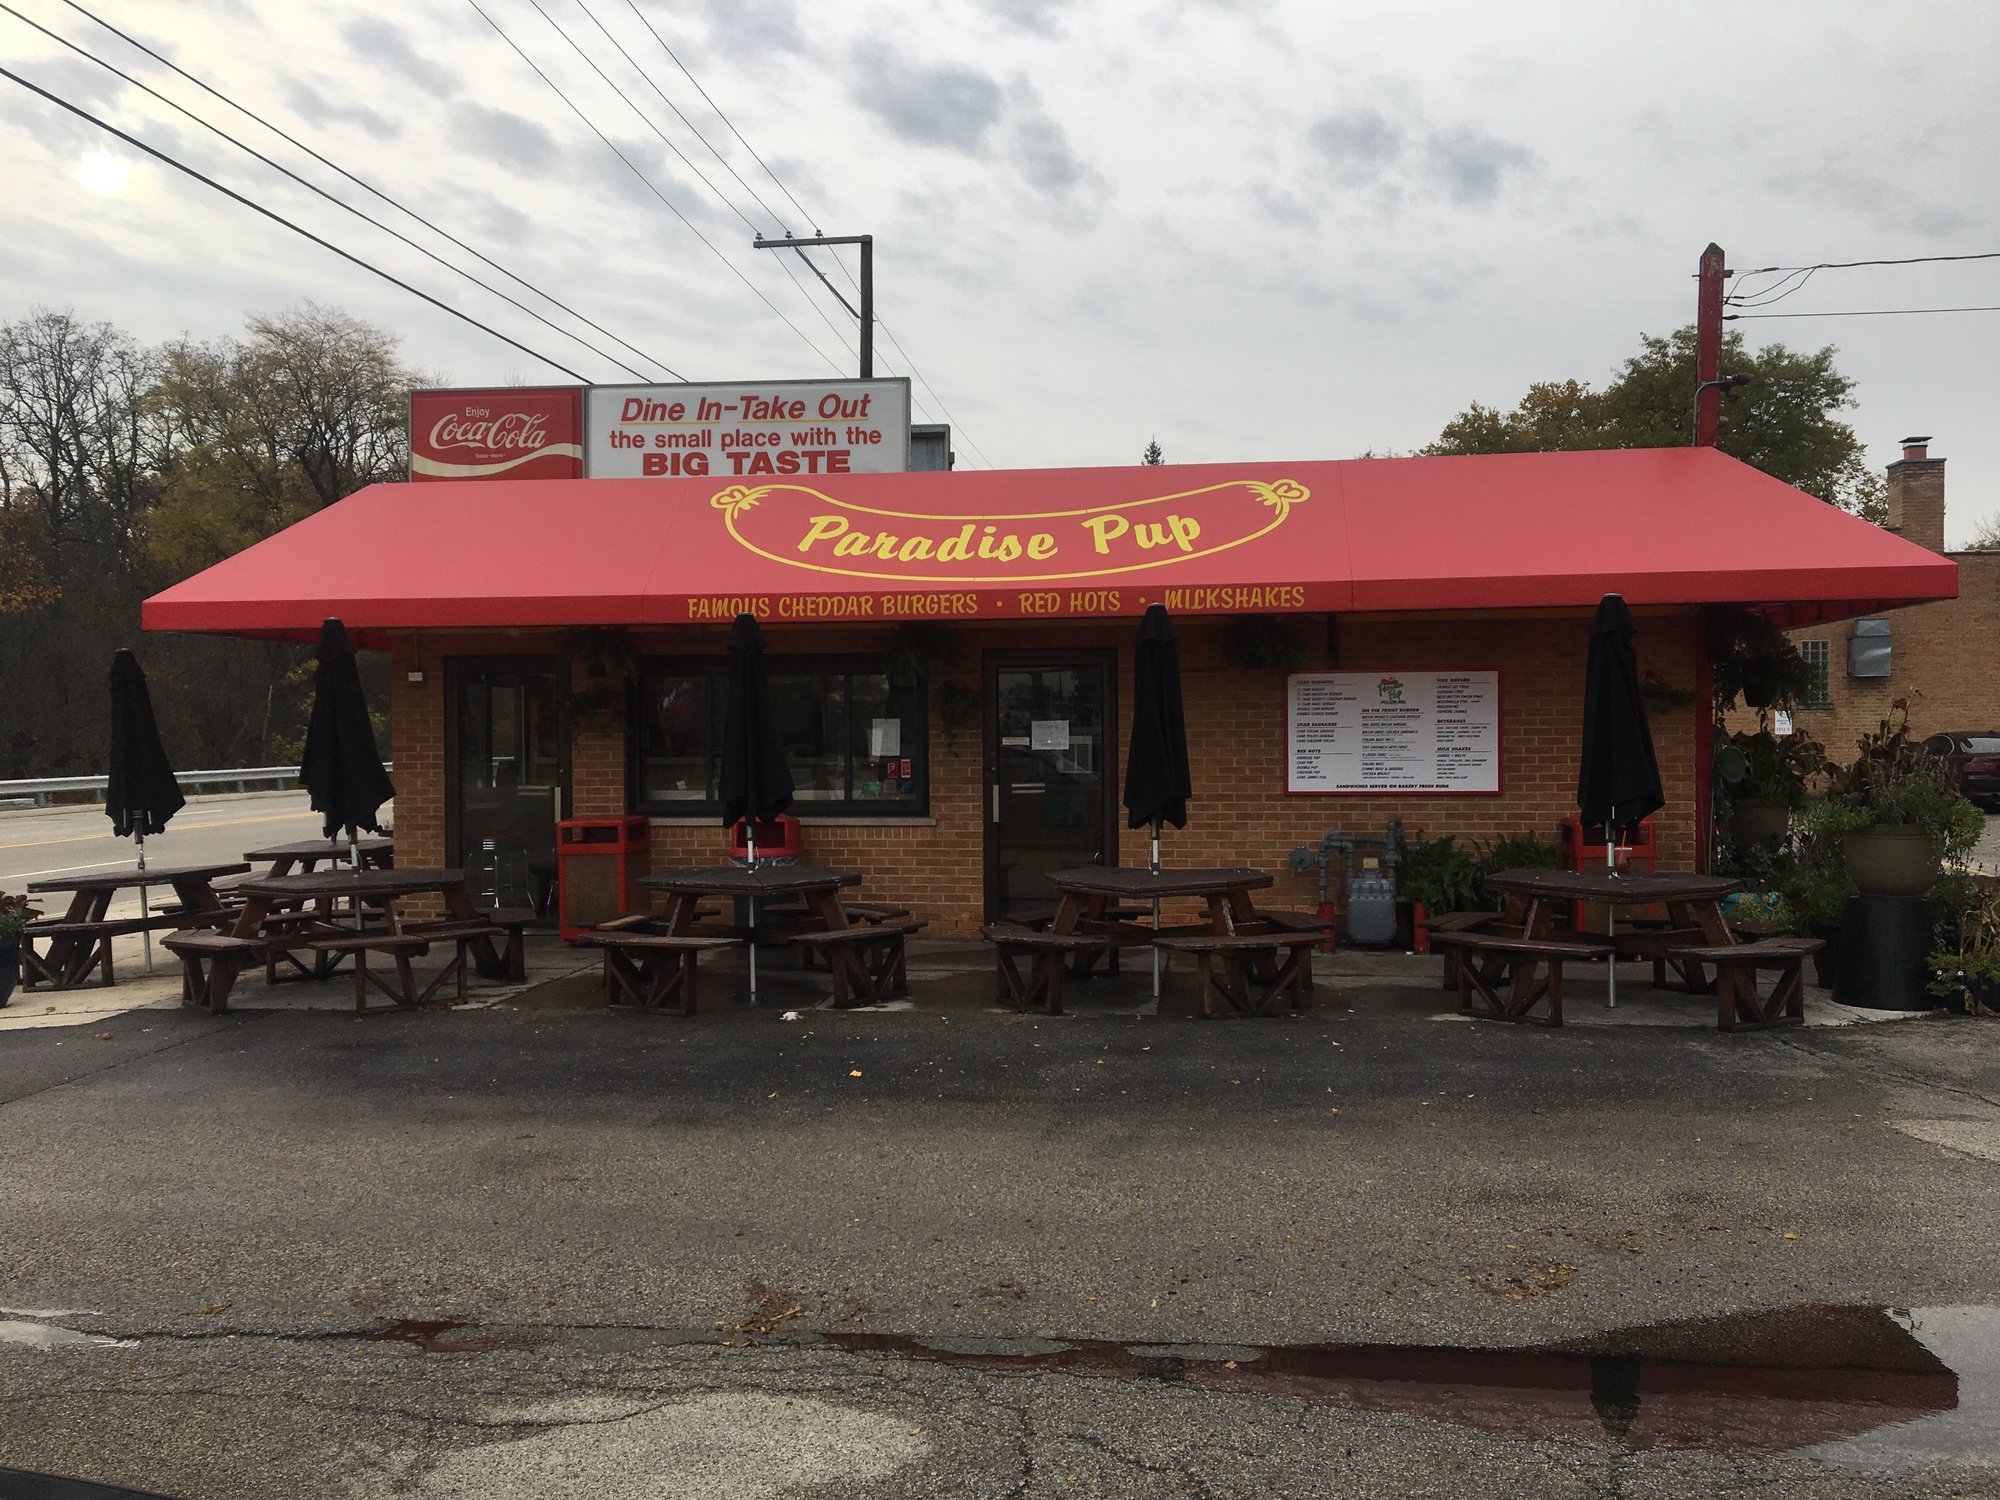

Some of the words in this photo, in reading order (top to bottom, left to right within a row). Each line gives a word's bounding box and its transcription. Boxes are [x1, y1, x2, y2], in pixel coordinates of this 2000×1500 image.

[465, 406, 490, 418] Enjoy
[621, 397, 685, 421] Dine
[818, 393, 871, 419] Out
[429, 413, 549, 449] Coca-Cola
[610, 430, 645, 448] the
[655, 429, 711, 448] small
[721, 429, 781, 451] place
[790, 427, 836, 446] with
[846, 426, 881, 445] the
[643, 452, 709, 476] BIG
[726, 450, 850, 475] TASTE
[797, 515, 1058, 563] Paradise
[1081, 514, 1200, 554] Pup
[688, 597, 771, 618] FAMOUS
[778, 595, 874, 617] CHEDDAR
[880, 593, 978, 616] BURGERS
[1019, 592, 1060, 613] RED
[1069, 591, 1121, 612] HOTS
[1164, 586, 1305, 609] MILKSHAKES
